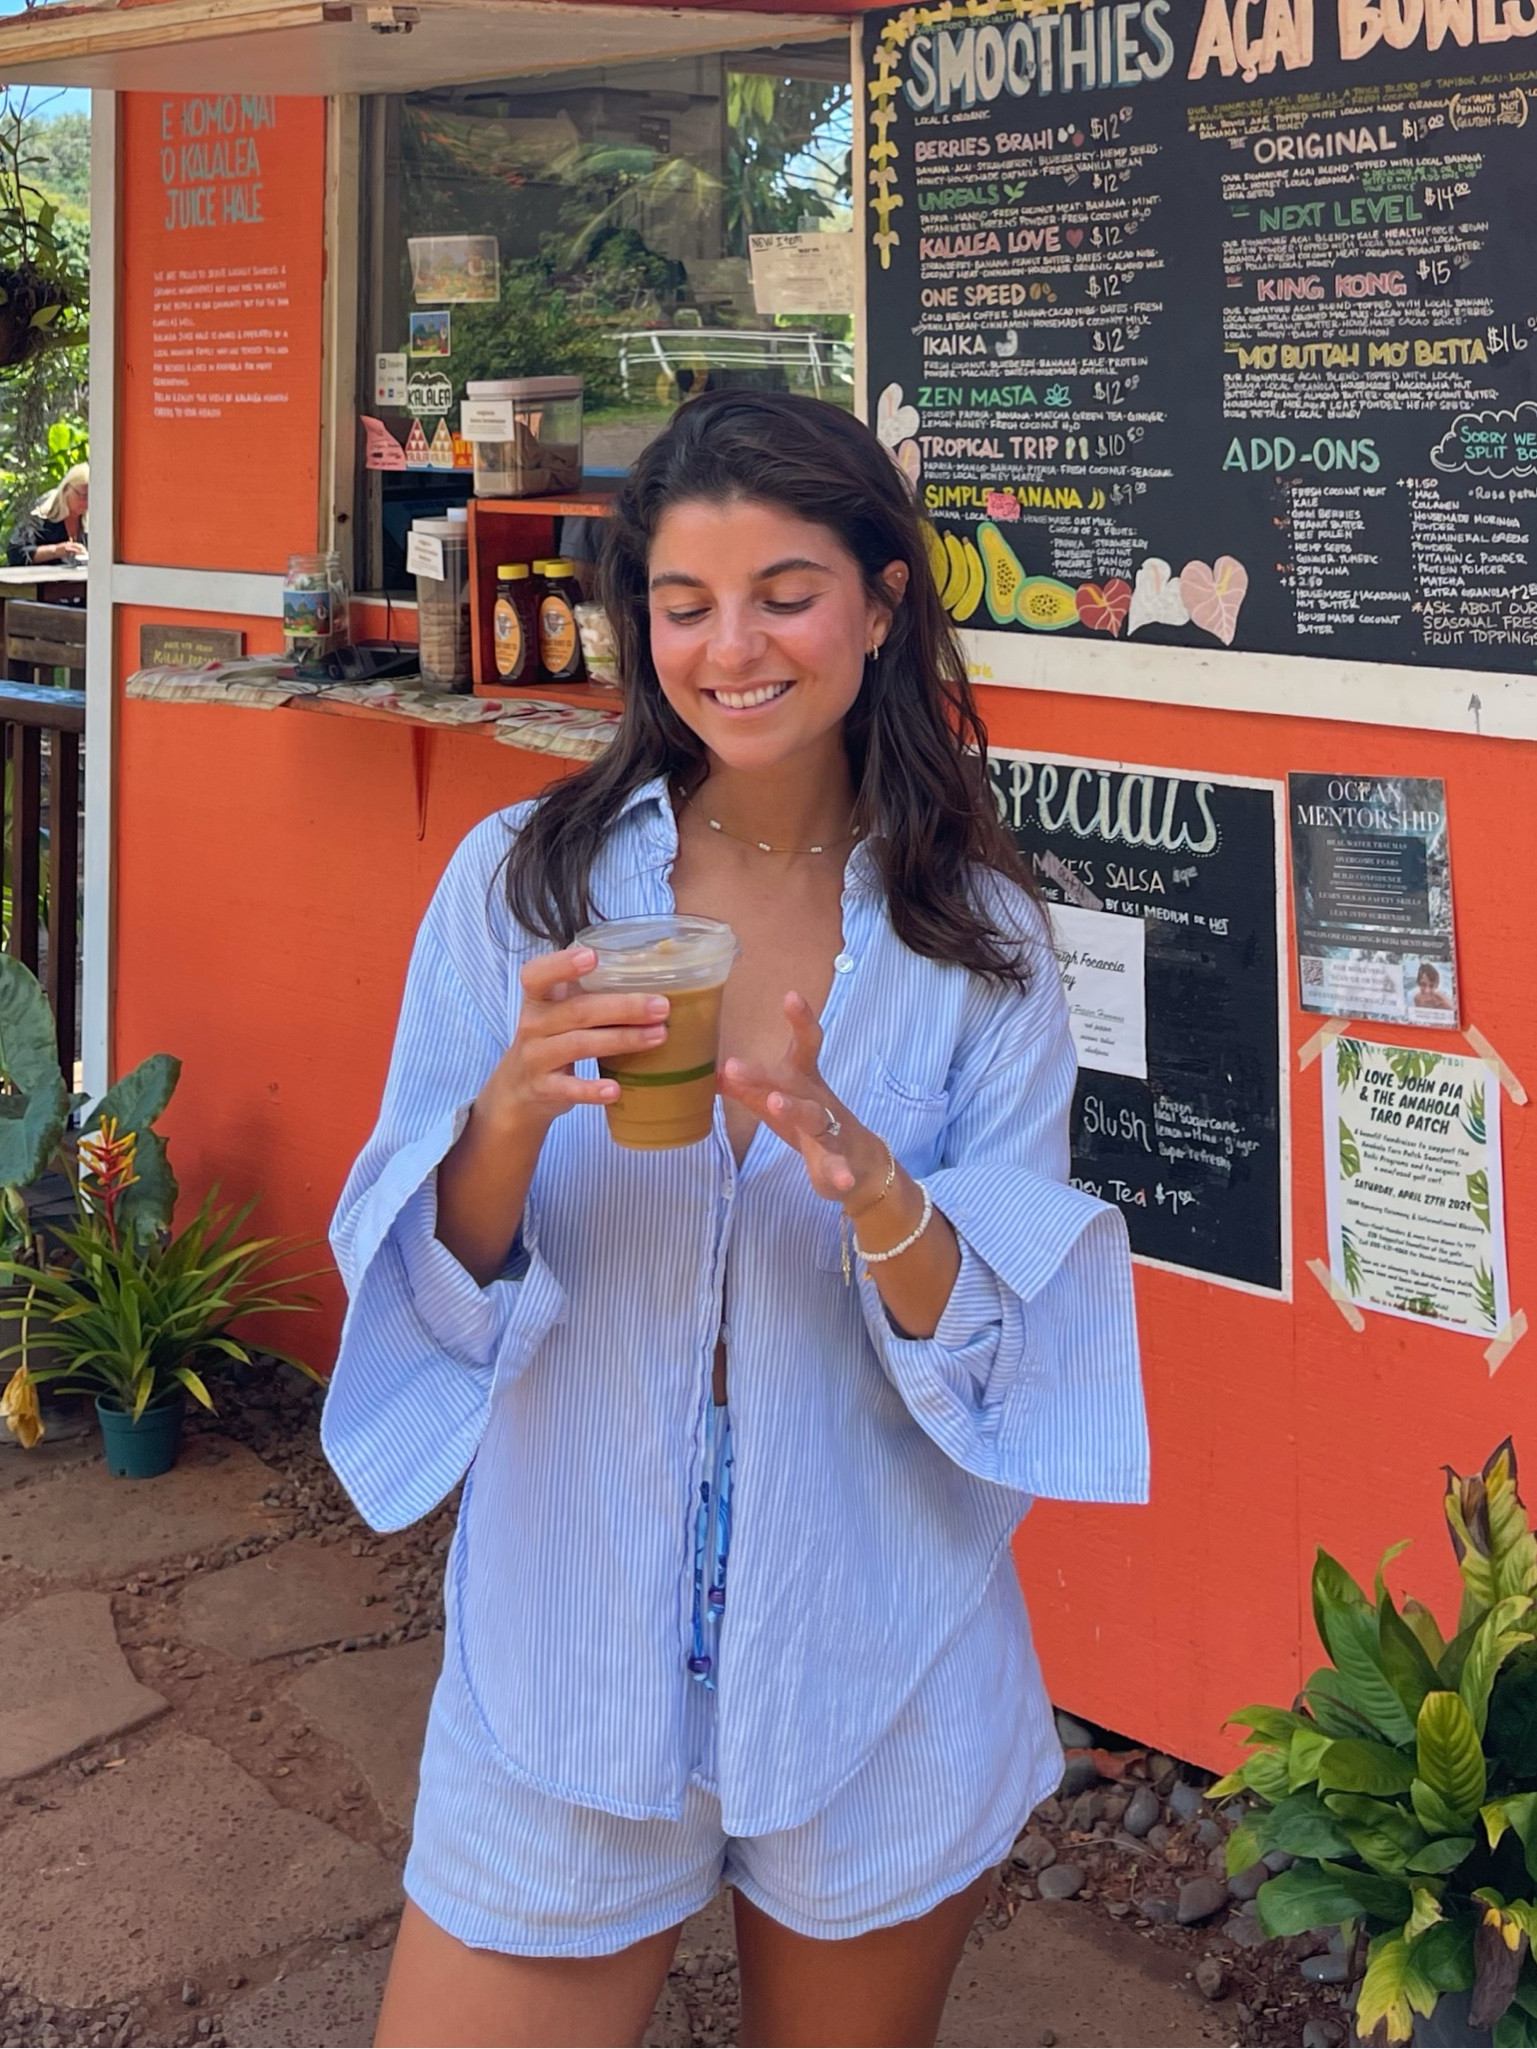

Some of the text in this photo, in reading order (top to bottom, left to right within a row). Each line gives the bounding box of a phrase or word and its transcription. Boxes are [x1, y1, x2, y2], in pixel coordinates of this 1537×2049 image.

[906, 0, 1175, 113] SMOOTHIES
[1501, 100, 1520, 113] NOT
[162, 102, 174, 140] E
[915, 136, 991, 162] BERRIES
[1253, 126, 1397, 165] ORIGINAL
[181, 137, 261, 182] KALALEA
[164, 183, 264, 230] JUICE HALE
[918, 184, 1000, 211] UNREALS
[1259, 202, 1325, 232] NEXT
[1334, 195, 1423, 228] LEVEL
[919, 231, 1001, 260] KALALEA
[1008, 226, 1061, 253] LOVE
[921, 286, 958, 308] ONE
[965, 283, 1026, 306] SPEED
[1258, 275, 1324, 302] KING
[1335, 271, 1407, 298] KONG
[923, 334, 987, 356] IKAIKA
[1281, 343, 1360, 369] BUTTAH
[1415, 338, 1487, 368] BETTA
[408, 388, 451, 407] KALALEA
[918, 387, 963, 407] ZEN
[970, 385, 1038, 408] MASTA
[918, 435, 1004, 460] TROPICAL
[1009, 437, 1059, 460] TRIP
[1460, 426, 1507, 444] SORRY
[1222, 437, 1380, 474] ADD-ONS
[1464, 446, 1508, 459] SPLIT
[1293, 498, 1319, 508] KALE
[1465, 553, 1474, 563] C
[1480, 553, 1527, 565] POWDER
[1420, 576, 1465, 587] MATCHA
[1459, 603, 1502, 615] ABOUT
[1423, 615, 1497, 630] SEASONAL
[1423, 631, 1464, 645] FRUIT
[1327, 780, 1402, 803] OCEAN
[1297, 804, 1440, 832] MENTORSHIP
[1105, 863, 1166, 895] SALSA
[1105, 899, 1119, 912] BY
[1144, 905, 1189, 925] MEDIUM
[1193, 915, 1205, 925] OR
[1209, 918, 1229, 935] HOT
[1080, 953, 1126, 972] Focaccia
[1355, 1068, 1463, 1099] I LOVE JOHN PIA
[1360, 1086, 1460, 1118] & THE ANAHOLA
[1370, 1107, 1450, 1135] TARO PATCH
[1108, 1180, 1147, 1207] Tea
[1398, 1190, 1422, 1202] APRIL
[1424, 1194, 1446, 1207] 27TH
[1448, 1199, 1471, 1212] 2024
